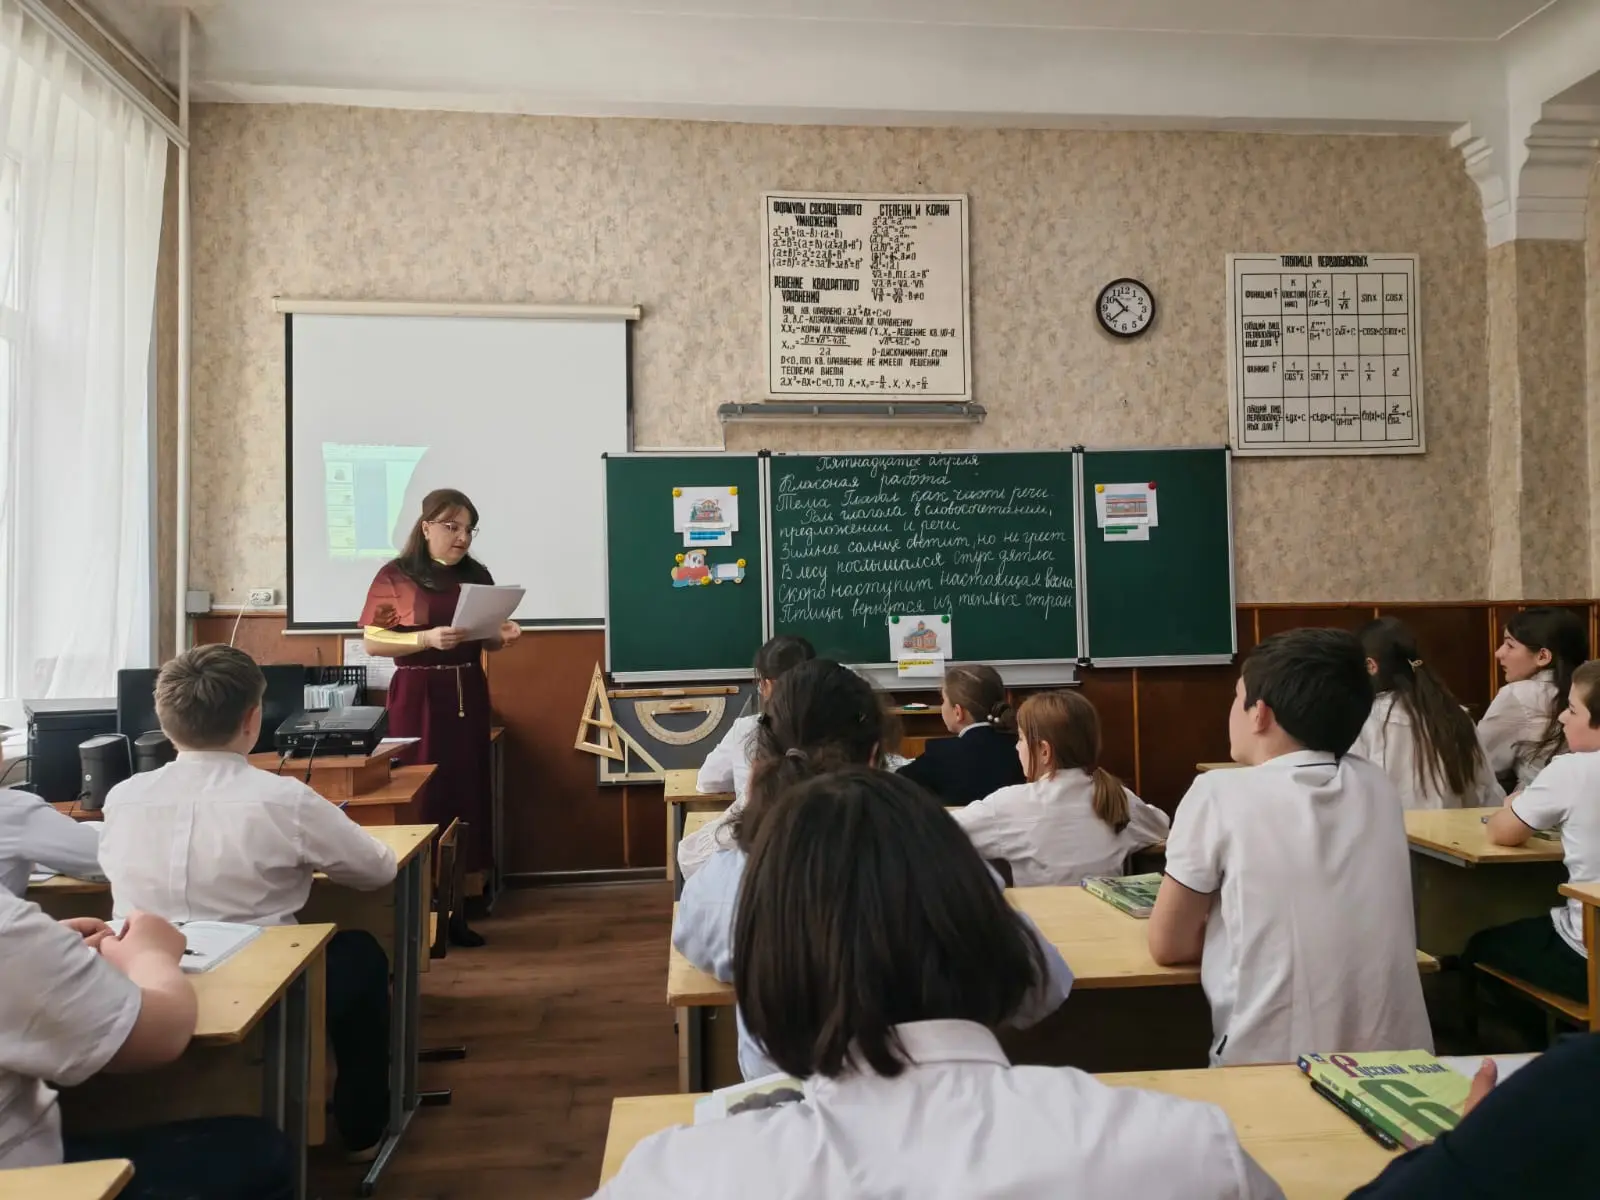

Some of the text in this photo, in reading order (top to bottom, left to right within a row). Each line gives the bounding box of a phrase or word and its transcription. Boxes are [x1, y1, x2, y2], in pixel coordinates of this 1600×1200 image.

[879, 203, 950, 216] СТЕПЕНИ И КОРНИ
[795, 215, 838, 228] УМНОЖЕНИЯ
[1280, 255, 1313, 268] ТАБЛИЦА
[774, 275, 804, 289] РЕШЕНИЕ
[812, 277, 860, 292] КВАДРАТНОГО
[1120, 286, 1131, 295] 12
[1137, 297, 1144, 305] 2
[1102, 304, 1109, 312] 9
[1141, 305, 1147, 313] 3
[1121, 323, 1128, 331] 6
[1131, 321, 1138, 329] 5
[866, 357, 876, 367] НЕ
[780, 366, 815, 376] ТЕОРЕМА
[879, 468, 951, 495] работа
[776, 492, 832, 512] Тема
[840, 489, 900, 507] Глагол
[910, 489, 949, 503] как
[840, 505, 907, 519] глагола
[914, 501, 921, 517] в
[779, 518, 961, 546] предложении и речи
[847, 538, 901, 553] солнце
[977, 533, 997, 545] но
[1003, 531, 1020, 543] не
[781, 548, 1056, 590] В лесу послышался стук дятла
[778, 583, 826, 612] Скоро
[831, 577, 934, 606] наступит
[940, 569, 1042, 590] настоящая
[779, 602, 844, 623] Птицы
[850, 597, 926, 628] вернутся
[933, 595, 954, 618] из
[1025, 592, 1075, 621] стран
[1329, 1054, 1409, 1078] Русский
